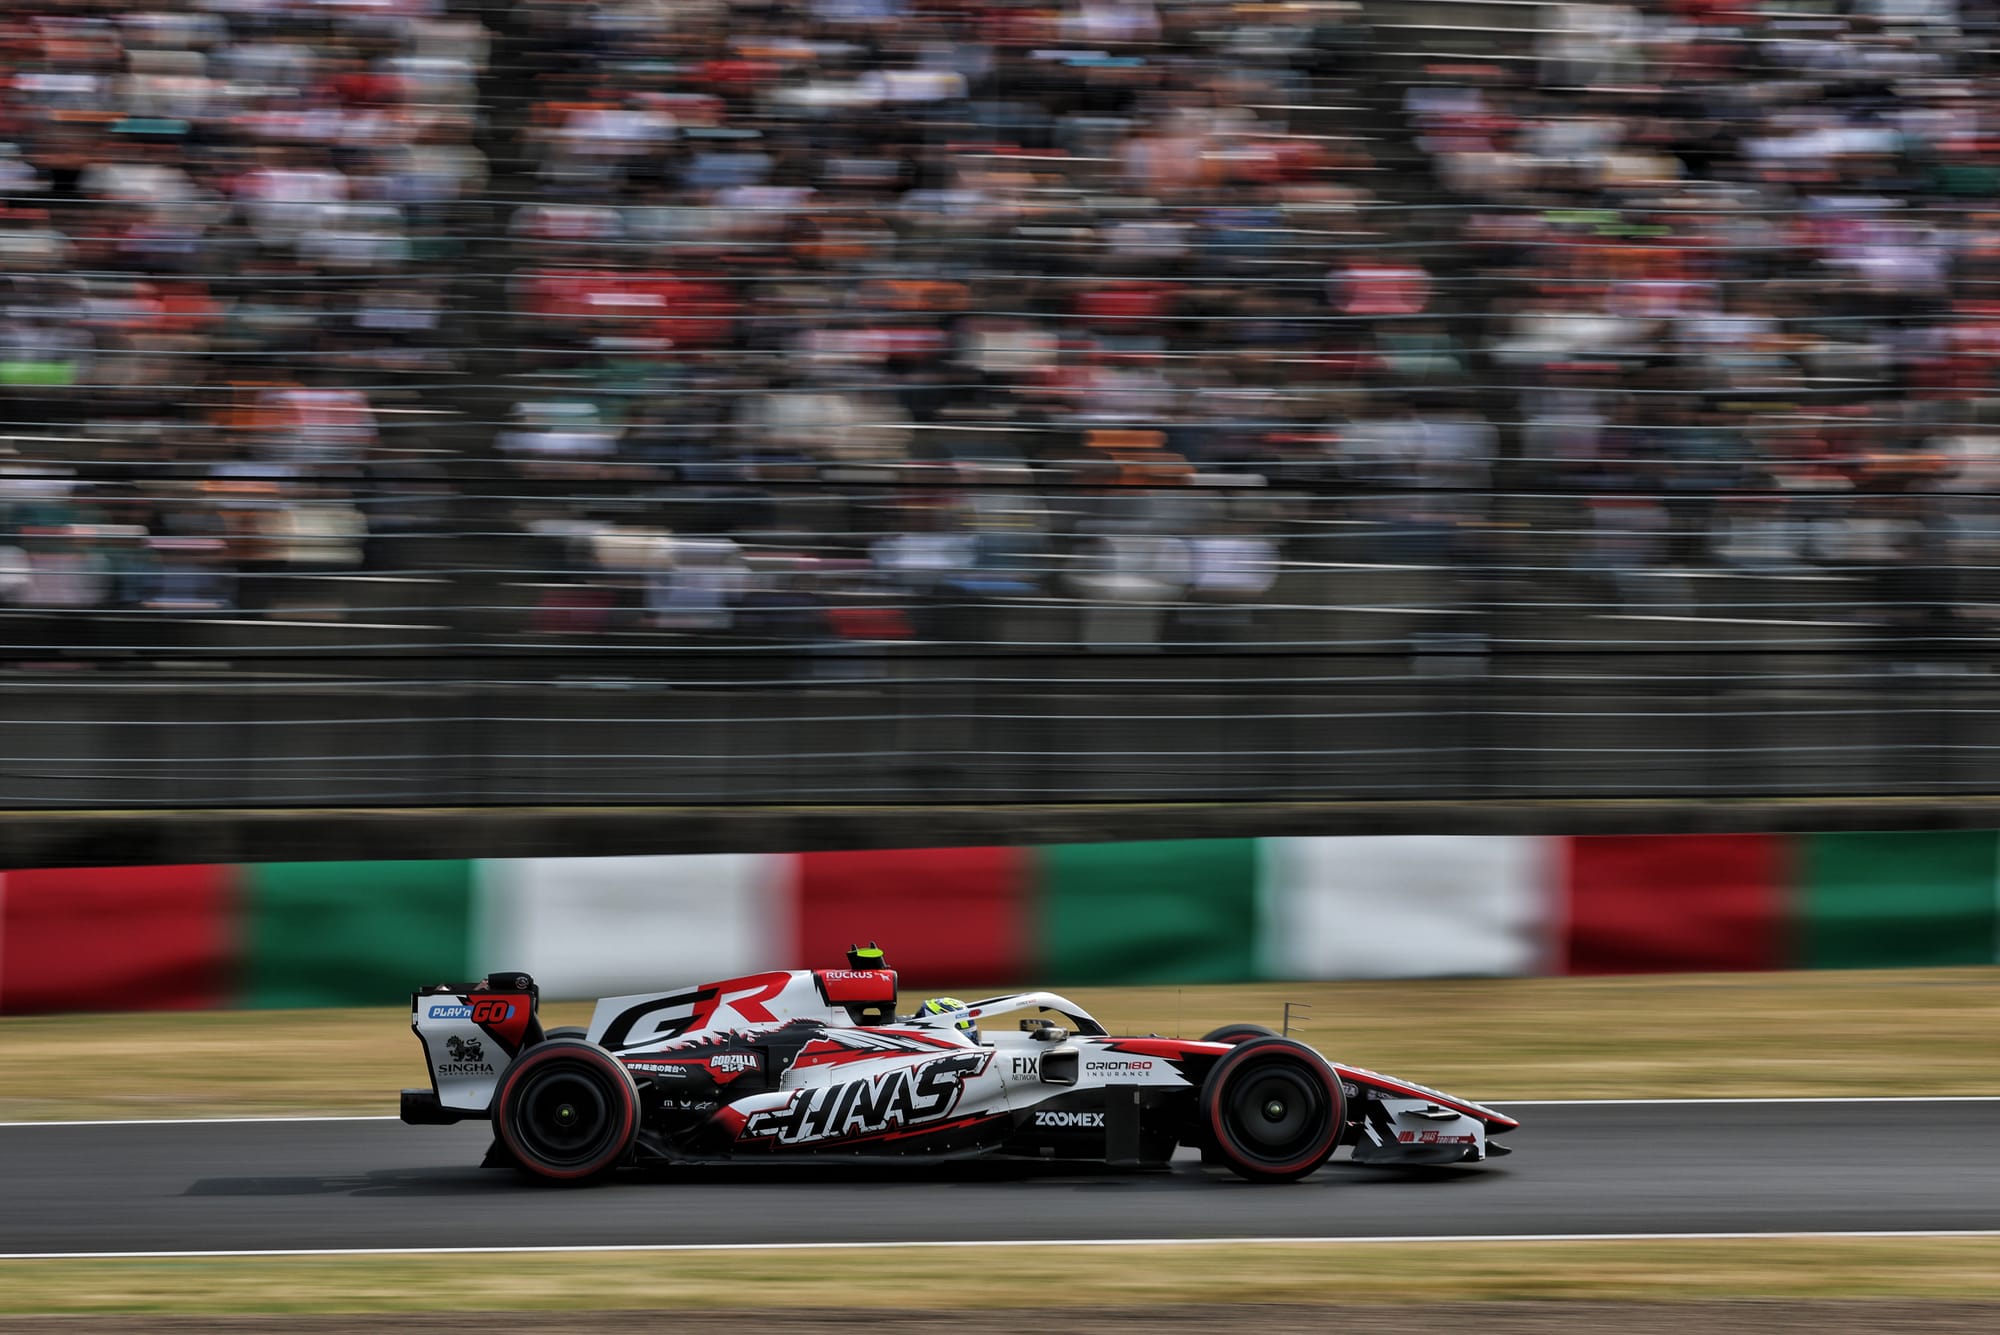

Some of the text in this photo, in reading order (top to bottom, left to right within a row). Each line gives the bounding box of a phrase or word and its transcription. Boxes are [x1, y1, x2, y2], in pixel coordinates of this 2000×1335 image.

[826, 971, 873, 979] RUCKUS
[432, 1001, 509, 1023] PLAY'n GO
[438, 1063, 494, 1073] SINGHA
[710, 1054, 757, 1068] GODZILLA
[1012, 1057, 1038, 1074] FIX
[747, 1052, 993, 1145] HAAS
[1035, 1112, 1105, 1127] ZOOMEX
